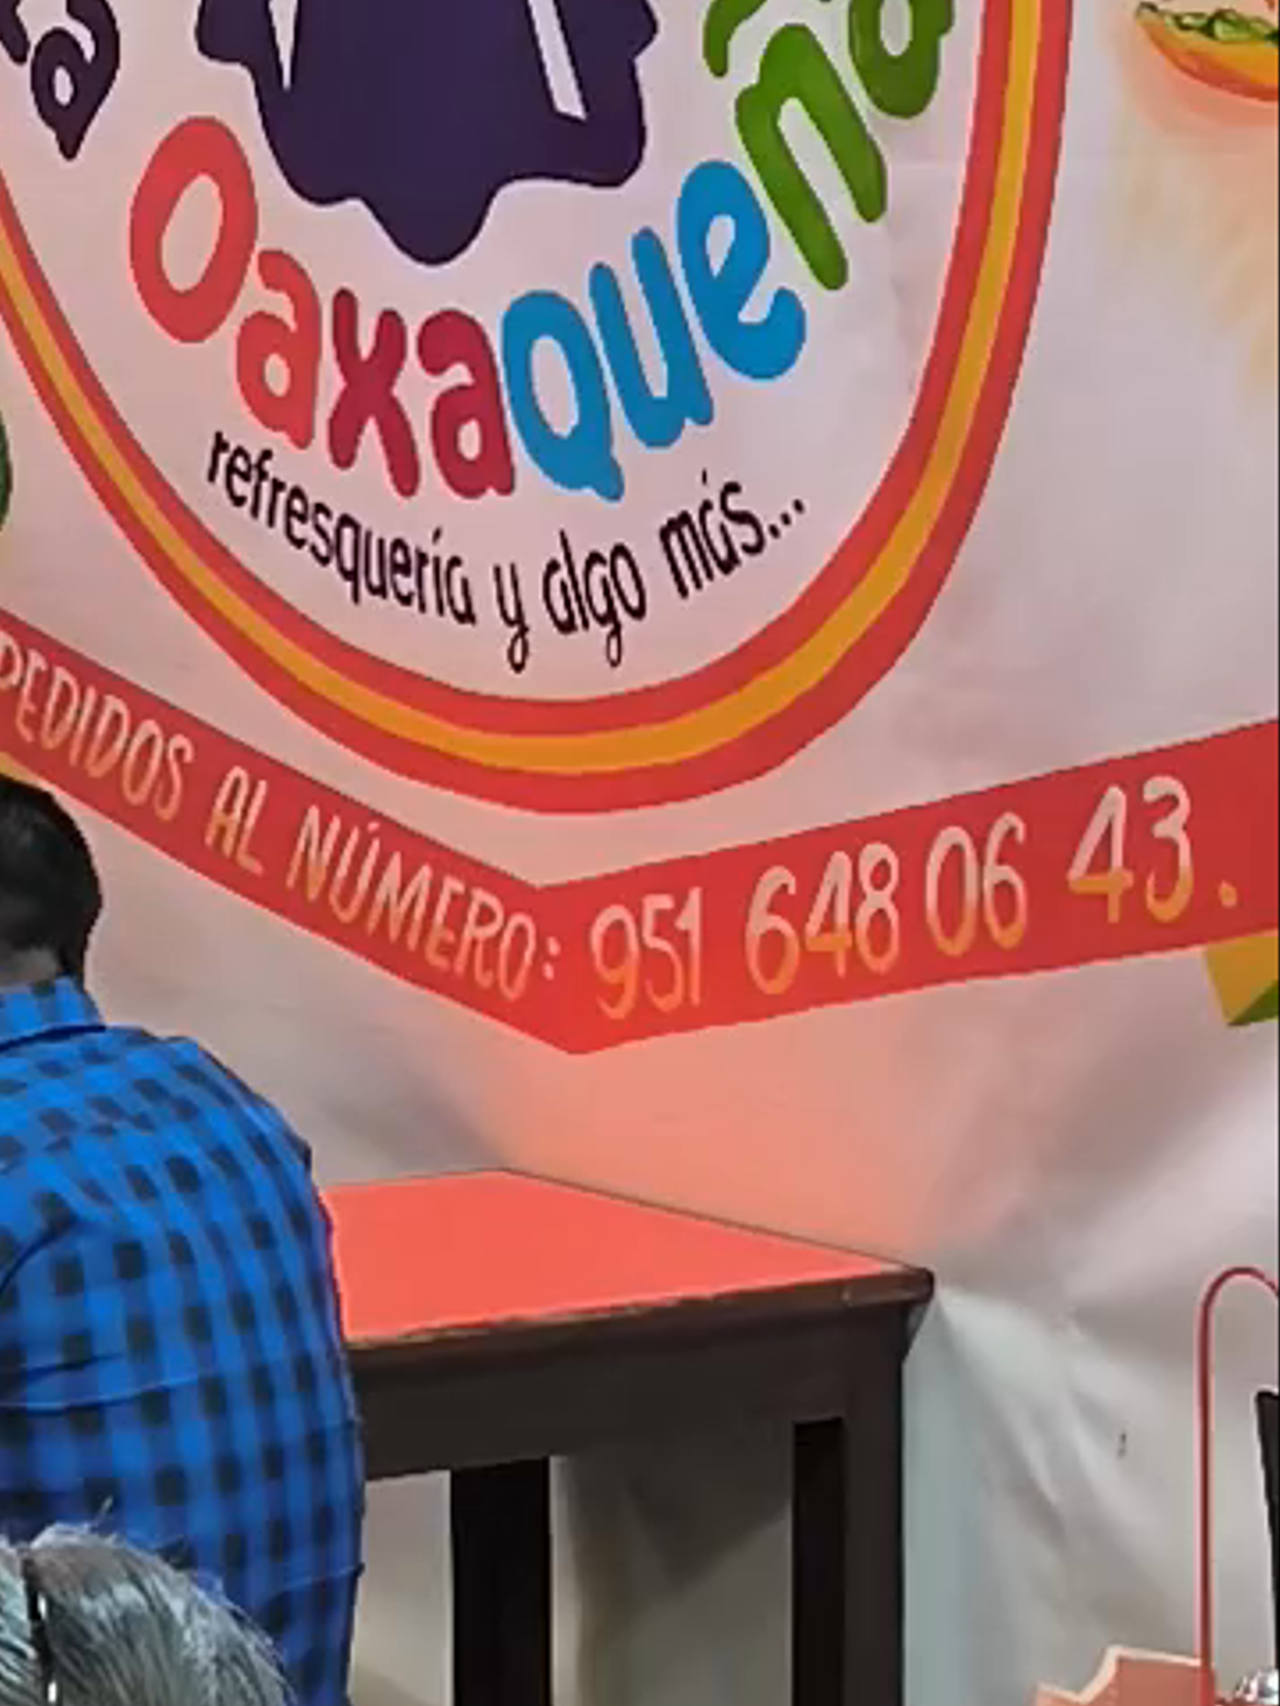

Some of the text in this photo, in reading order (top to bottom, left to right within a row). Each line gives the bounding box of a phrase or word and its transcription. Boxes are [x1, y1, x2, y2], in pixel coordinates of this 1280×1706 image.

[207, 431, 477, 625] refresquería
[493, 561, 530, 674] y
[543, 531, 647, 668] algo
[207, 765, 266, 879] AL
[287, 815, 562, 1003] NÚMERO:
[590, 885, 705, 1020] 951
[747, 842, 902, 992] 648
[926, 812, 1029, 954] 06
